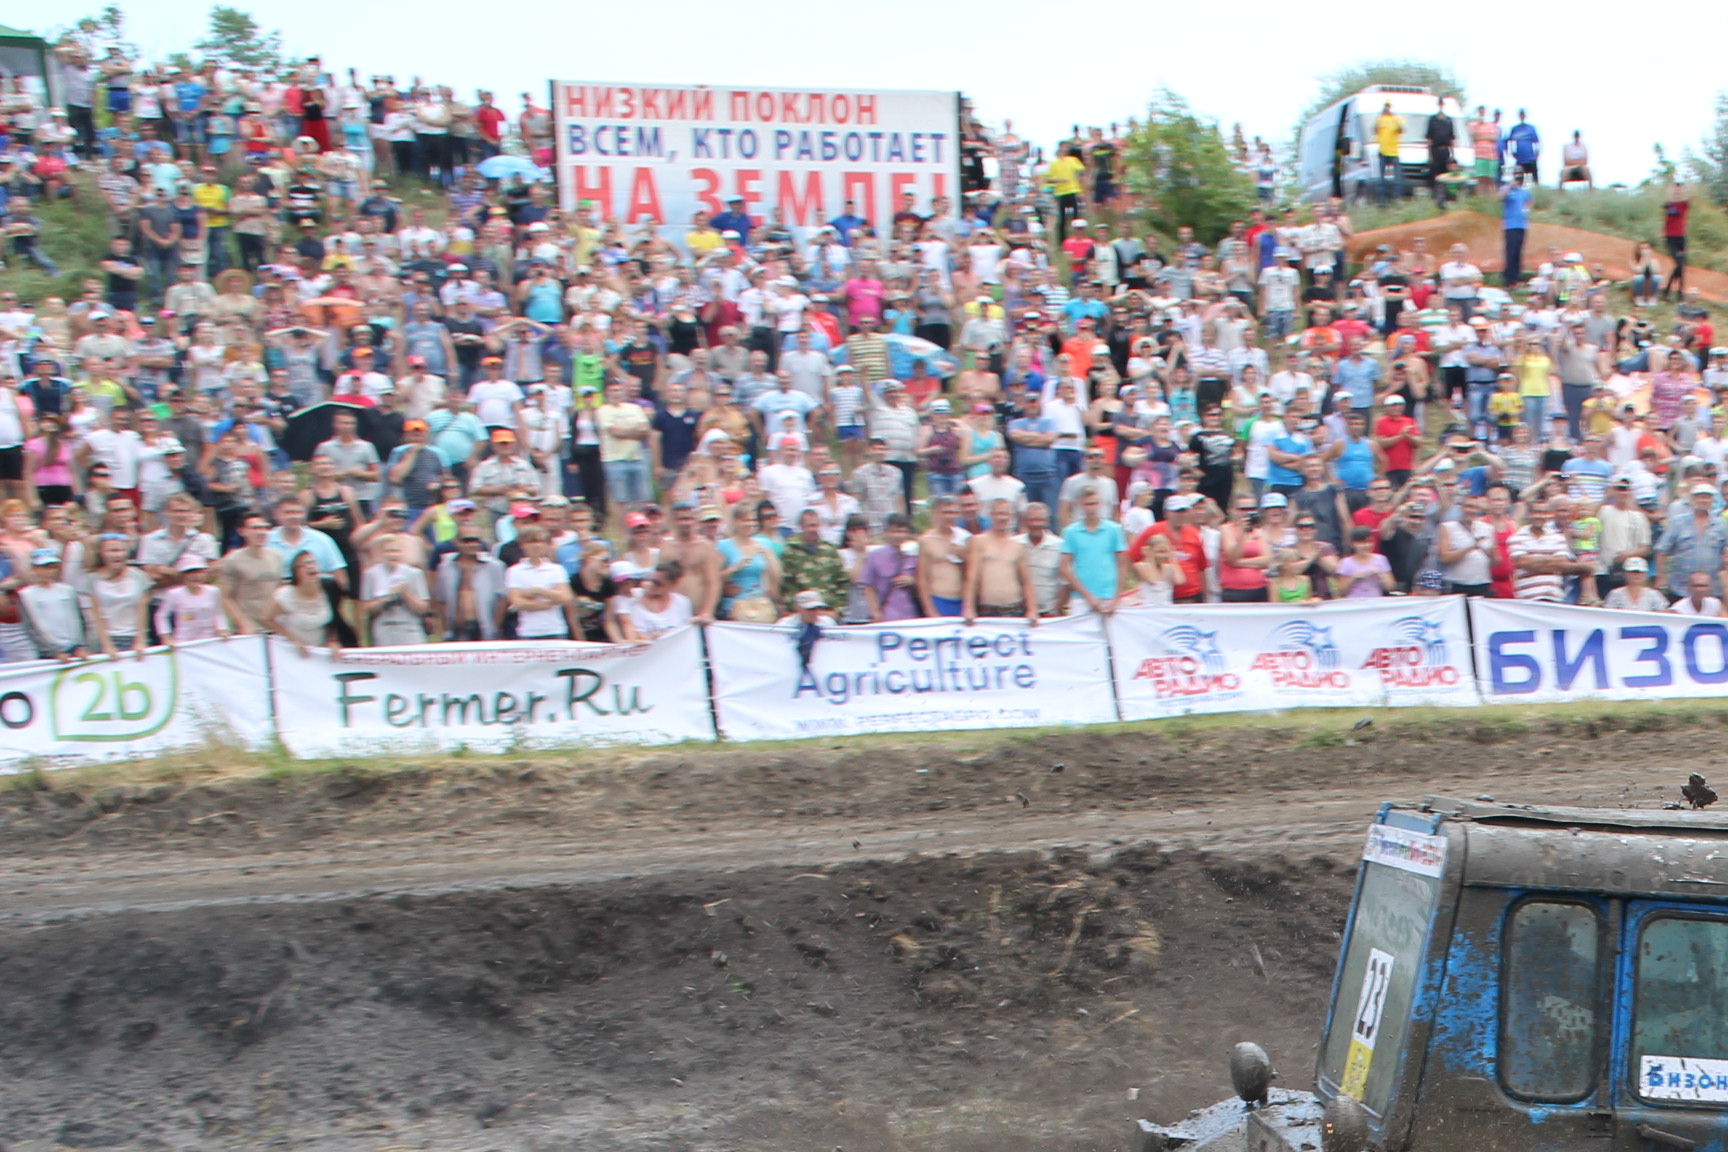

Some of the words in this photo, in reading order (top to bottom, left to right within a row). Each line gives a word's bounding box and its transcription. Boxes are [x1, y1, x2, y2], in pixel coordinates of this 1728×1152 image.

[565, 85, 714, 121] НИЗКИЙ
[730, 91, 878, 125] ПОКЛОН
[567, 124, 678, 162] ВСЕМ,
[692, 128, 759, 159] КТО
[775, 129, 947, 163] РАБОТАЕТ
[574, 165, 667, 225] НА
[876, 629, 1035, 663] Perfect
[74, 671, 152, 721] 2b
[332, 668, 655, 728] Fermer.Ru
[793, 661, 1038, 705] Agriculture
